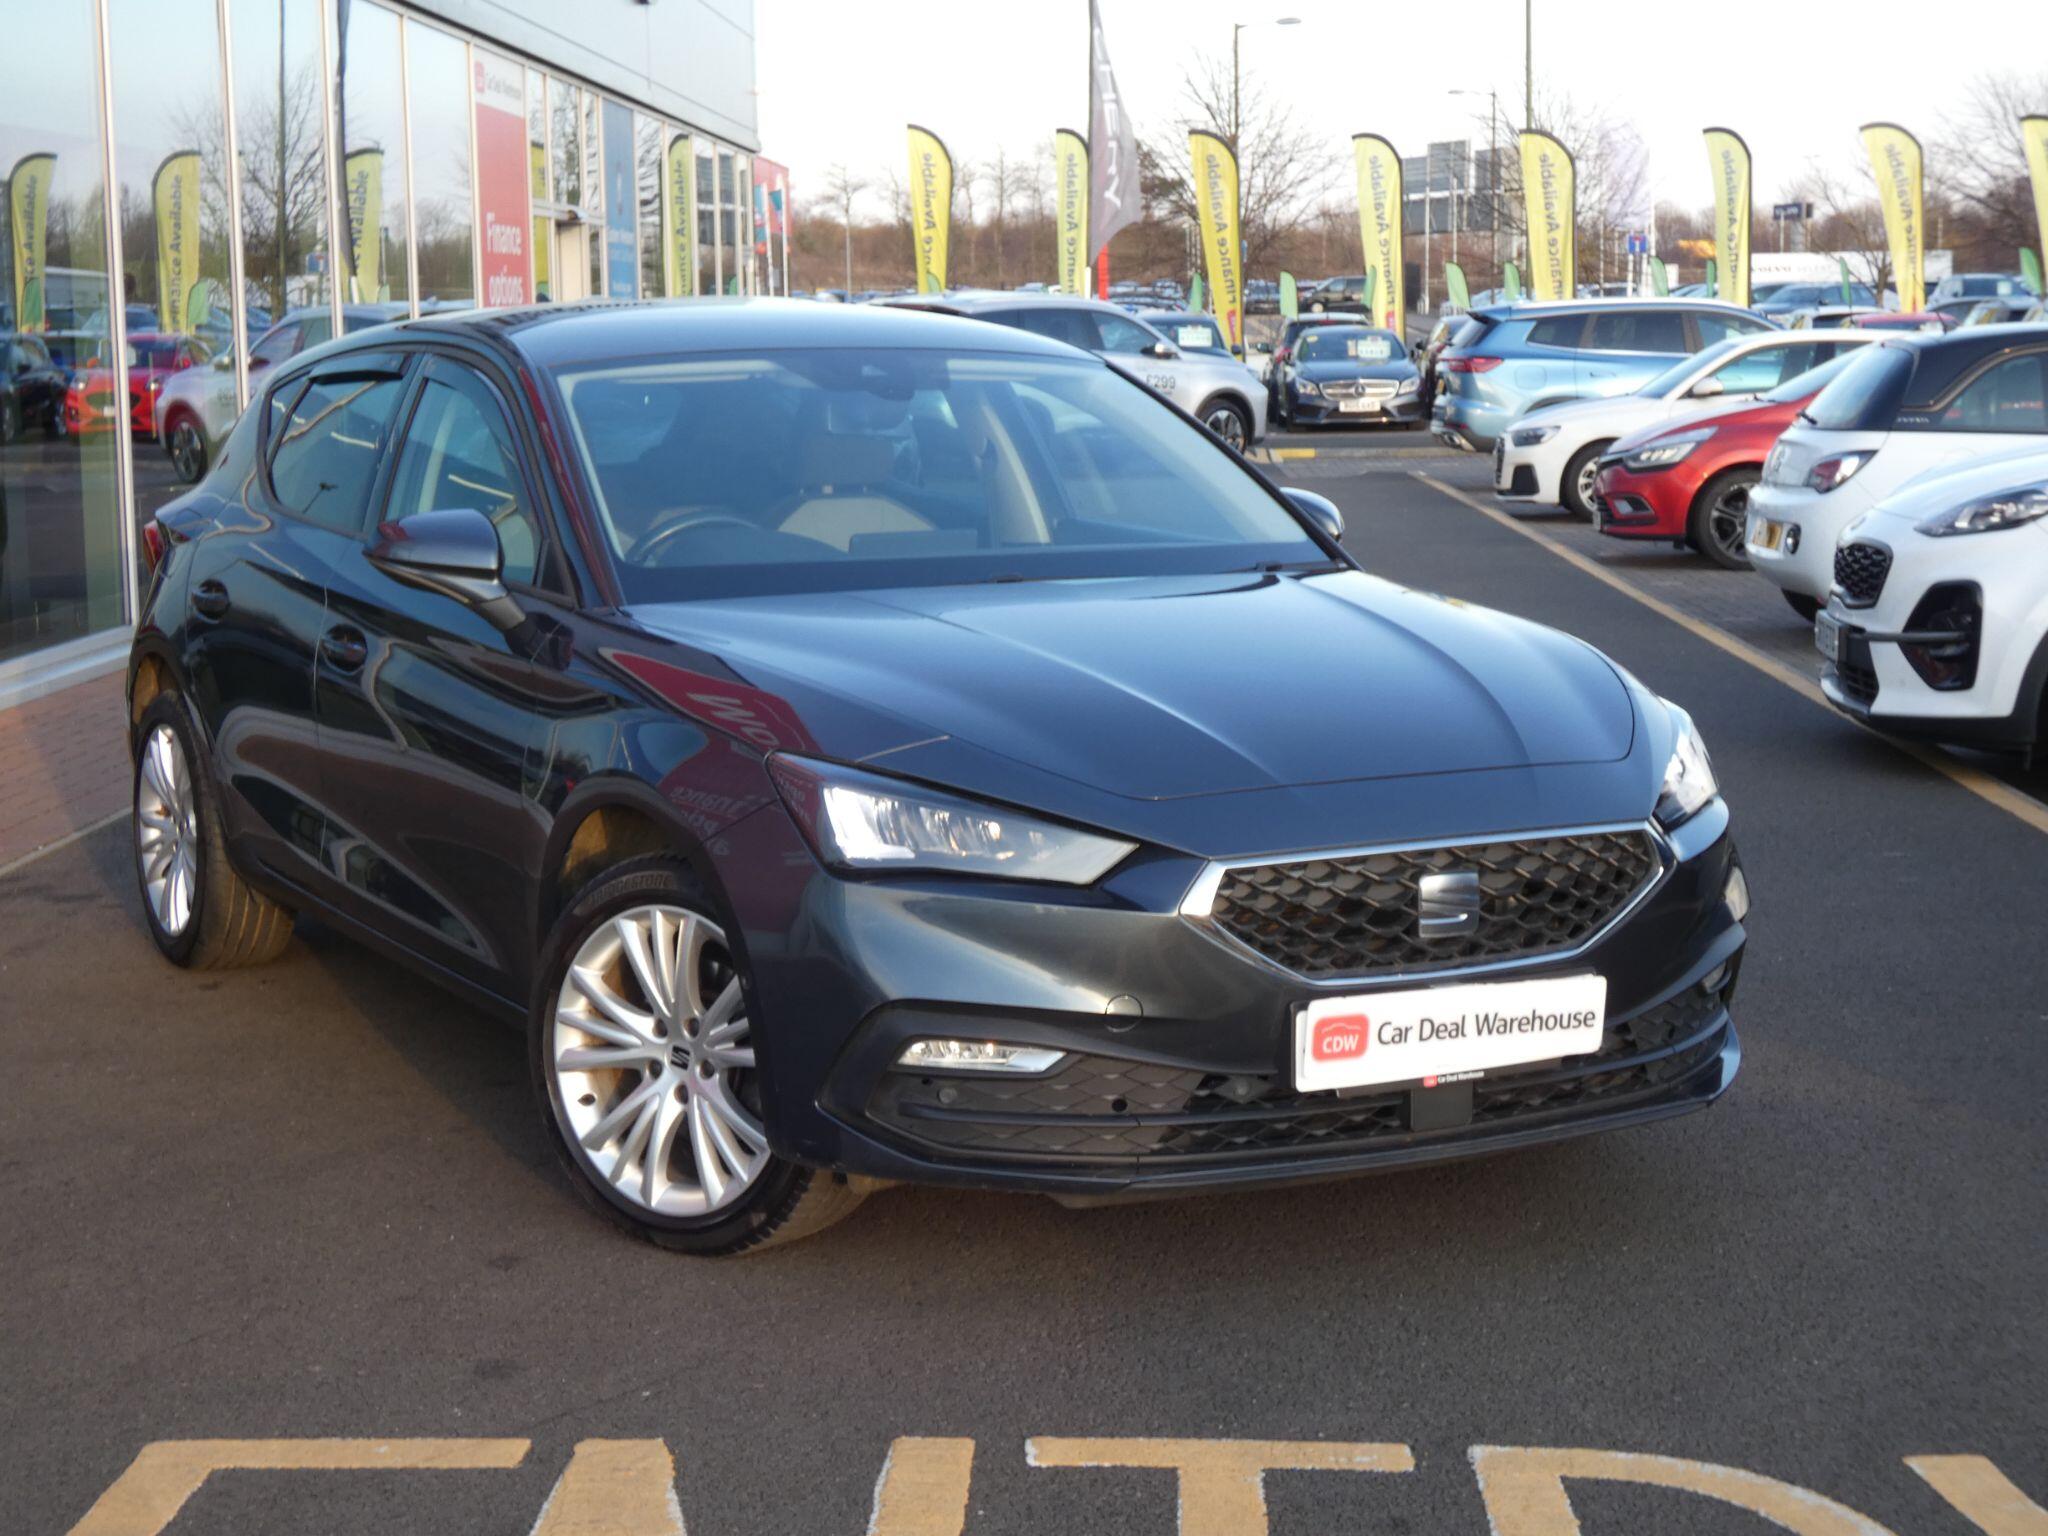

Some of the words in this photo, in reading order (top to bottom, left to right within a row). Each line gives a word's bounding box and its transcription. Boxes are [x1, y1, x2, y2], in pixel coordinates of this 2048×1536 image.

[169, 174, 183, 254] Available
[674, 159, 686, 237] Available
[1321, 1033, 1359, 1055] CDW
[1376, 1021, 1412, 1047] Car
[1418, 1014, 1467, 1042] Deal
[1474, 1008, 1597, 1038] Warehouse
